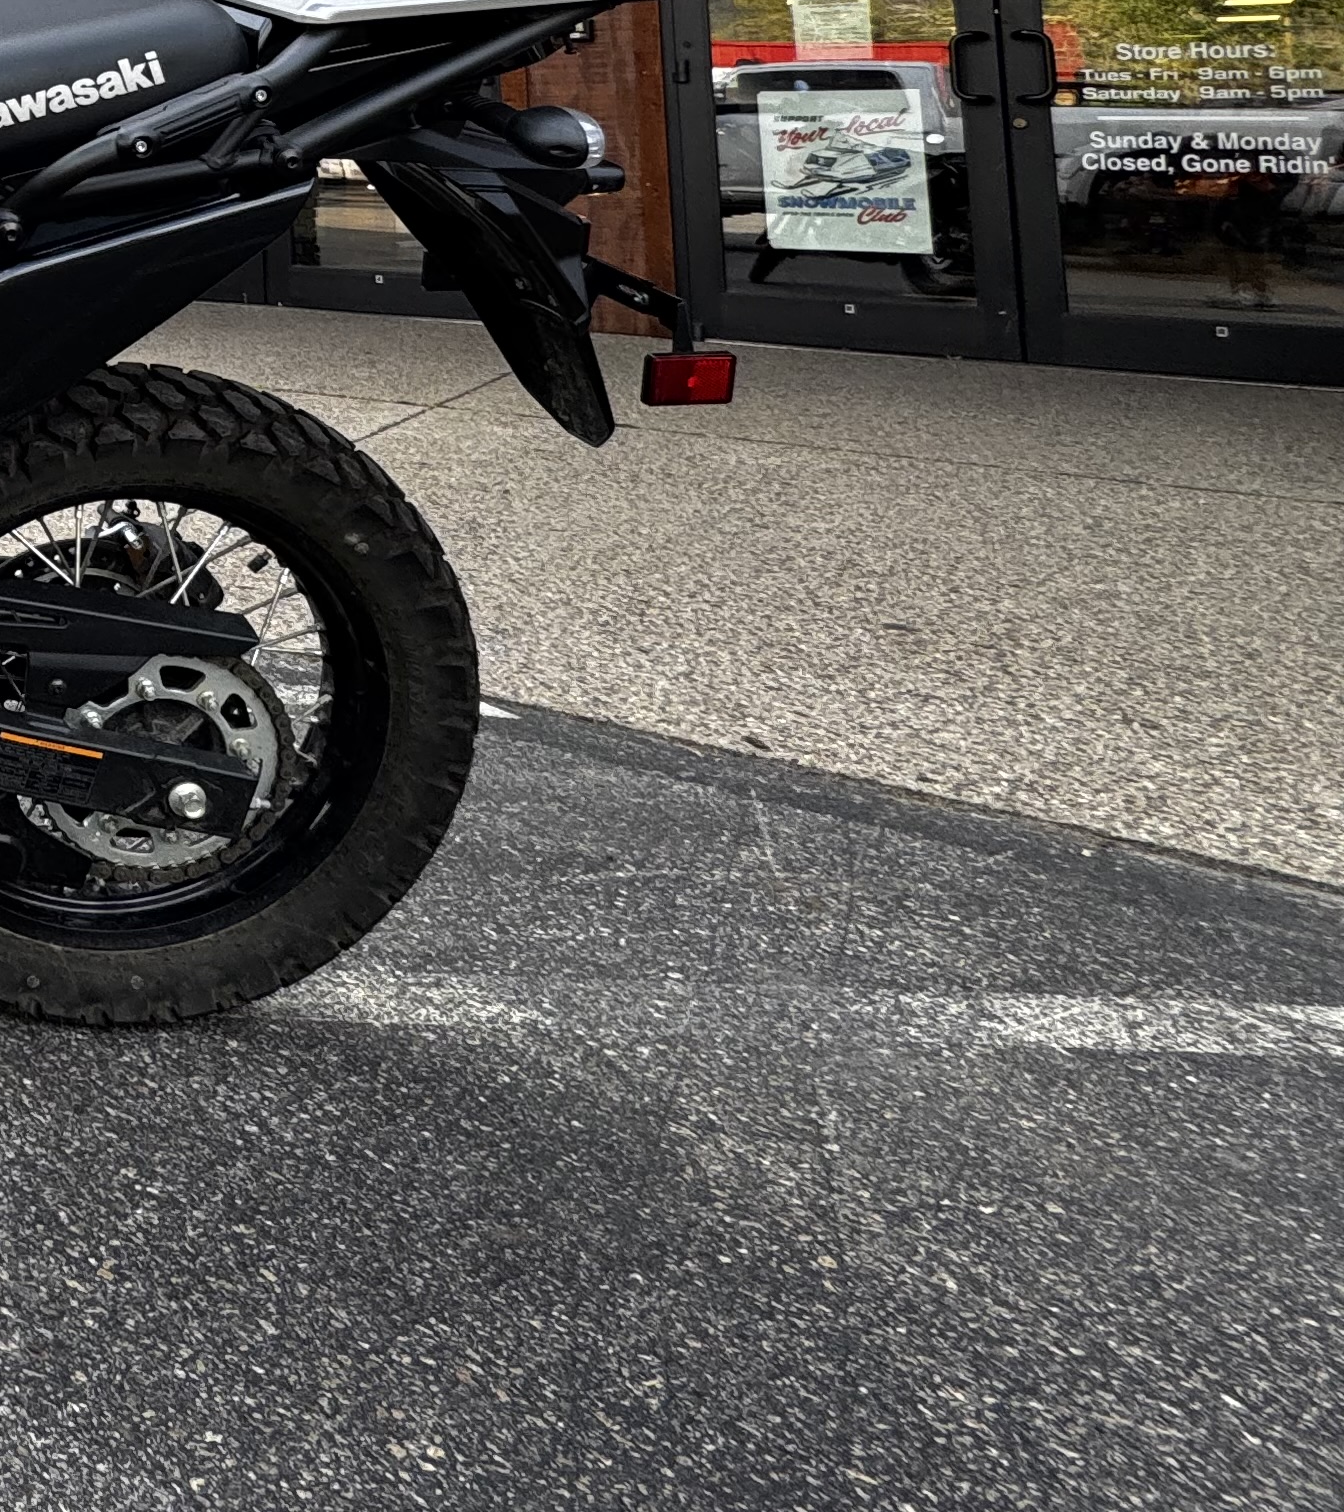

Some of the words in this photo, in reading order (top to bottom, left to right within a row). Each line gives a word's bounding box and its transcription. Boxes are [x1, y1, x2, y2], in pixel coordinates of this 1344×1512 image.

[1116, 42, 1181, 61] Store
[1190, 41, 1276, 59] Hours:
[1080, 68, 1131, 82] Tues
[1150, 68, 1178, 81] Fri
[1198, 67, 1250, 81] 9am
[1269, 66, 1323, 83] 6pm
[1082, 87, 1181, 102] Saturday
[1199, 86, 1251, 100] 9am
[1270, 85, 1325, 101] 5pm
[1089, 131, 1182, 152] Sunday
[1191, 132, 1210, 150] &
[1218, 132, 1322, 155] Monday
[1081, 153, 1175, 175] Closed,
[1181, 154, 1251, 173] Gone
[1259, 155, 1336, 175] Ridin'
[778, 196, 916, 210] SNOWMOBILE
[857, 206, 908, 225] Club
